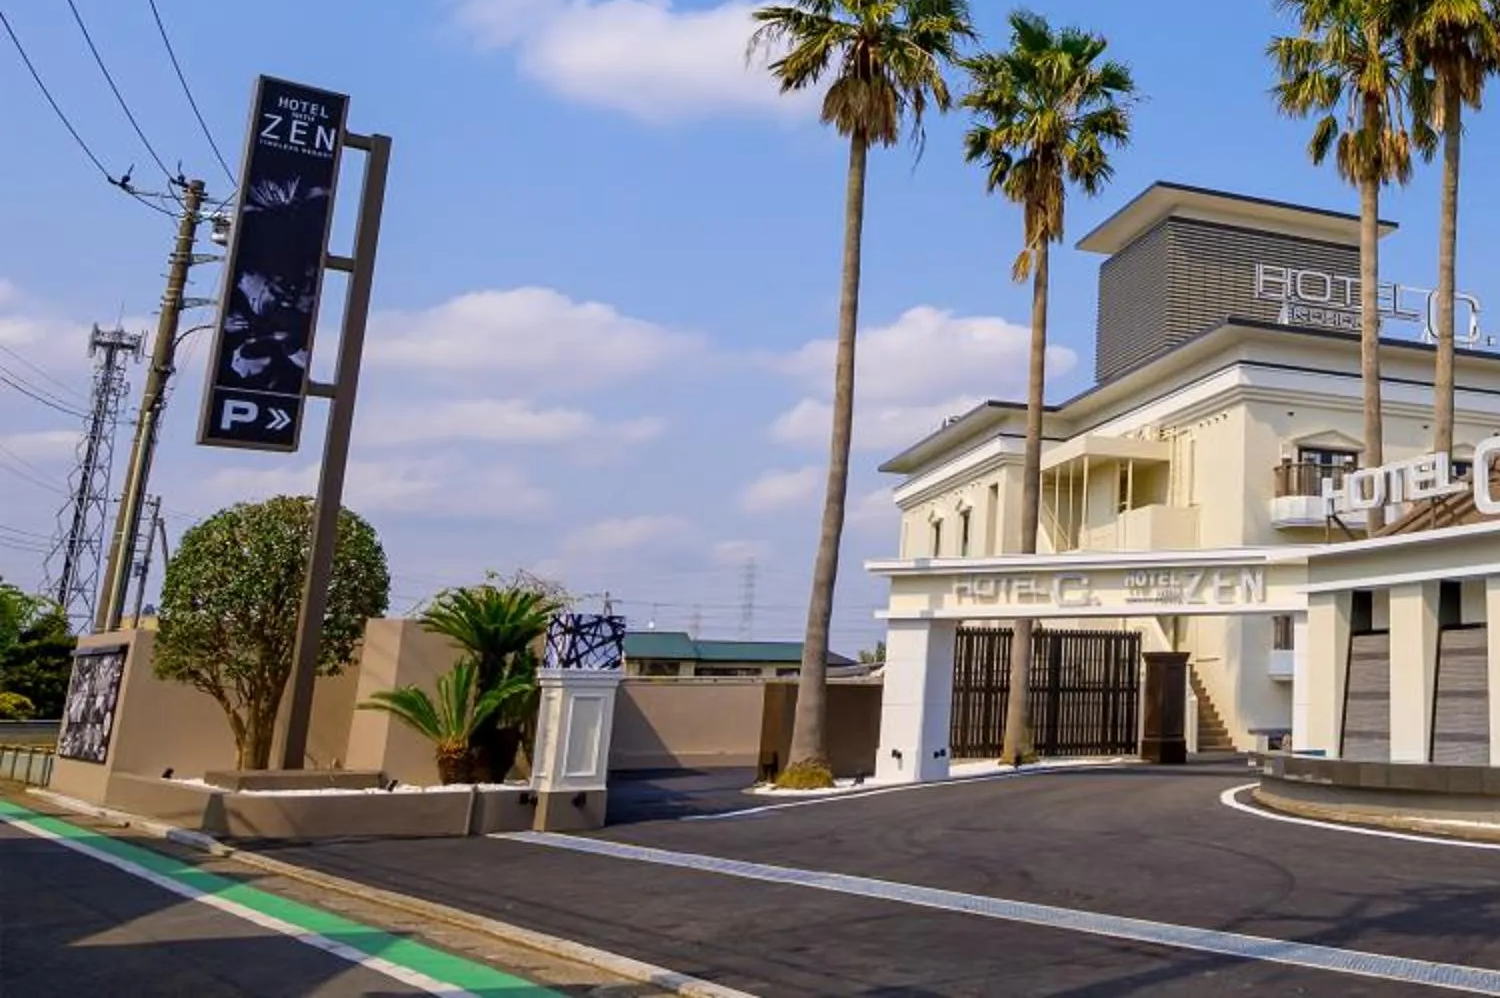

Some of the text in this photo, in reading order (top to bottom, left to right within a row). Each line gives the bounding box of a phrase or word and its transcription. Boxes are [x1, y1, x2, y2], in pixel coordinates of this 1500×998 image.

[278, 96, 329, 119] HOTEL
[261, 113, 336, 151] ZEN
[220, 399, 259, 430] P
[1322, 451, 1469, 516] HOTEL
[953, 575, 1050, 604] HOTEL
[1124, 569, 1180, 587] HOTEL
[1183, 565, 1267, 605] ZEN
